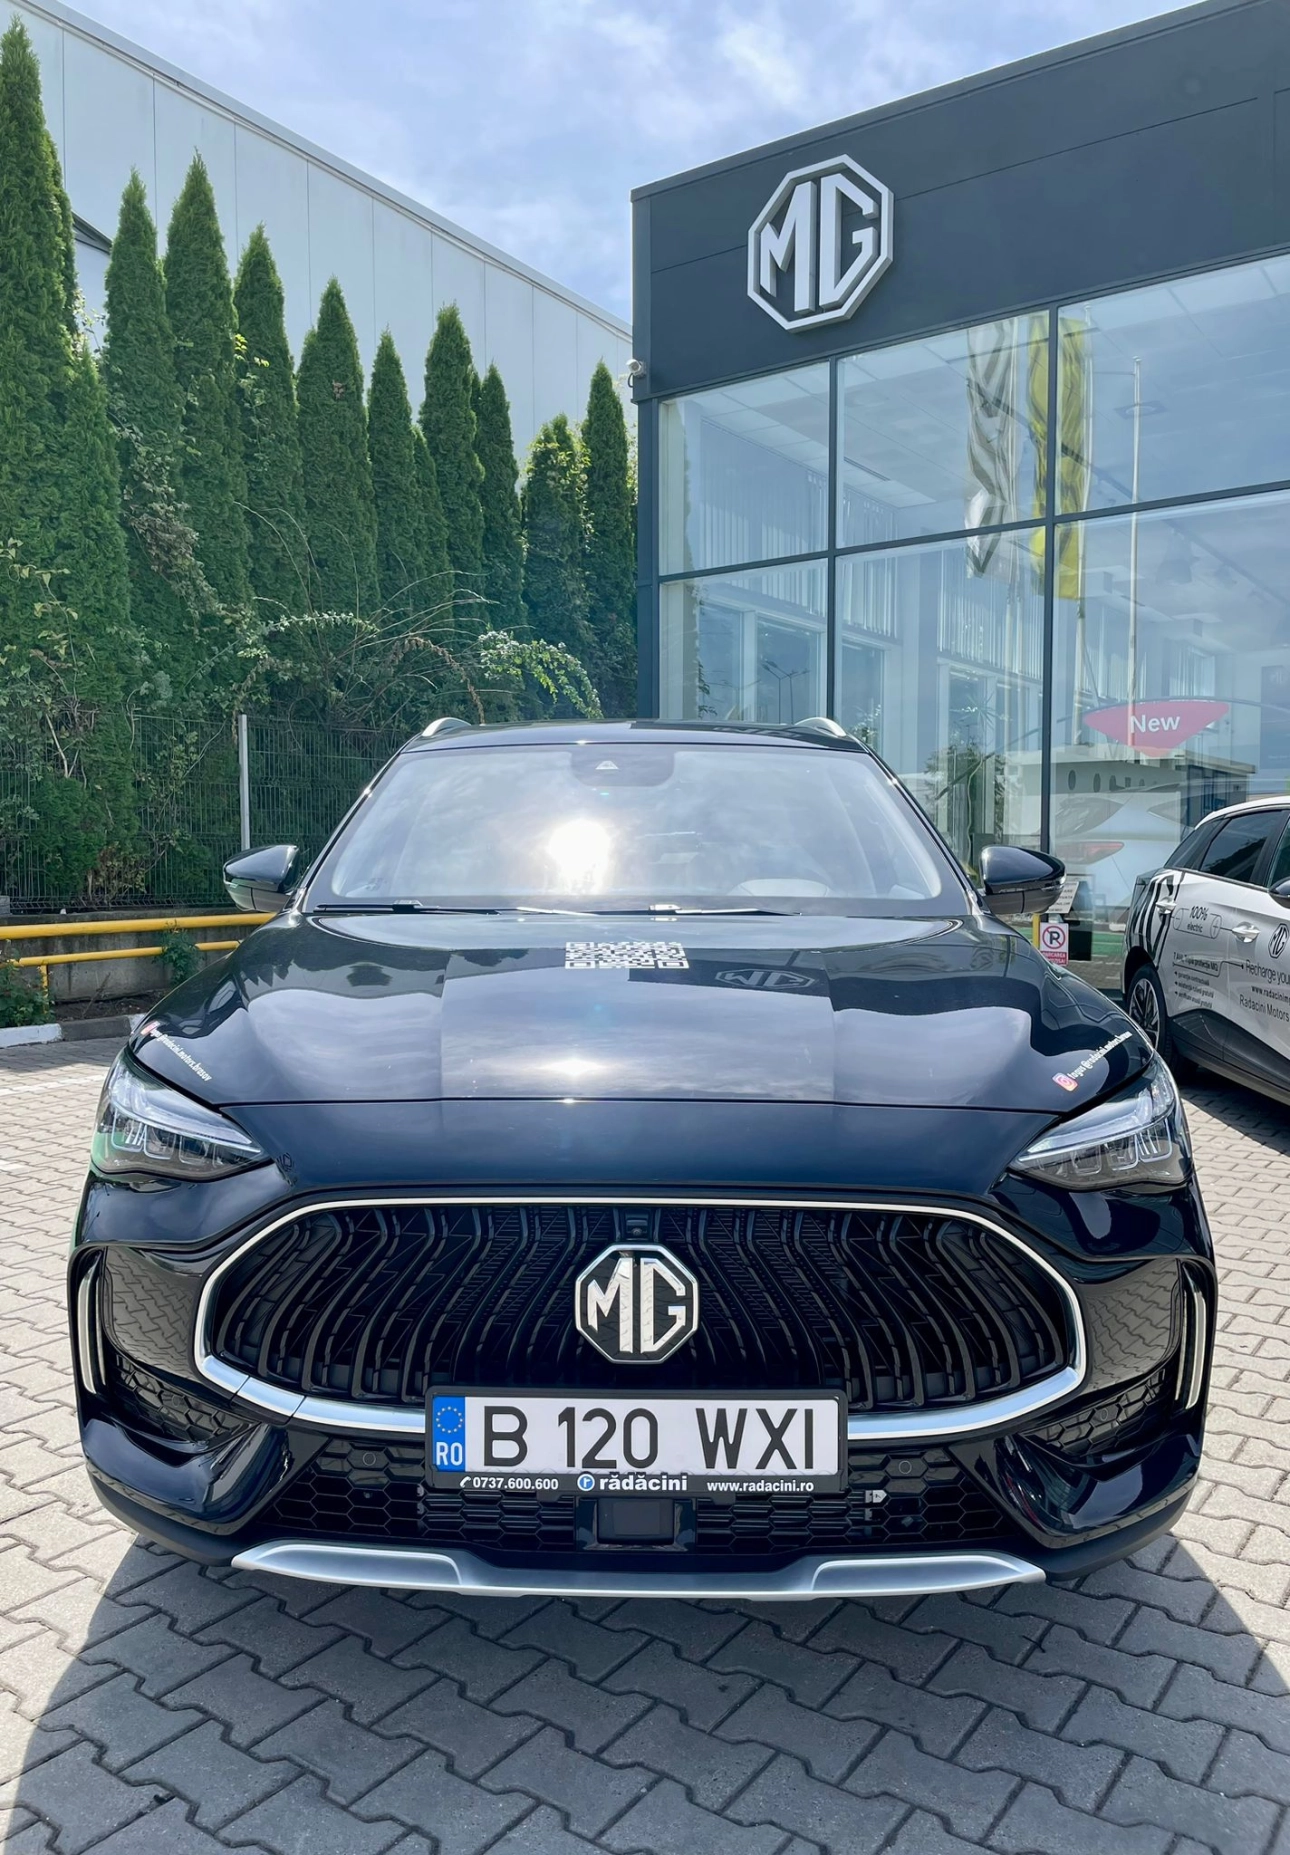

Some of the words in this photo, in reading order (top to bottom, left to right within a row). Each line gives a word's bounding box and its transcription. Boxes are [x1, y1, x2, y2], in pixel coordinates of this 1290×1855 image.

[760, 173, 879, 315] MG
[1130, 715, 1180, 733] New
[1189, 905, 1209, 920] 100%
[1269, 924, 1289, 957] MG
[1246, 960, 1276, 984] Recharge
[1240, 994, 1266, 1013] Radacini
[1267, 1003, 1290, 1022] Motors
[586, 1257, 687, 1354] MG
[484, 1405, 527, 1467] B
[557, 1407, 658, 1469] 120
[695, 1408, 813, 1470] WXI
[436, 1442, 462, 1466] RO
[472, 1476, 559, 1490] 0737.600.600
[599, 1474, 688, 1491] rădăcini
[706, 1479, 815, 1492] www.radacini.ro
